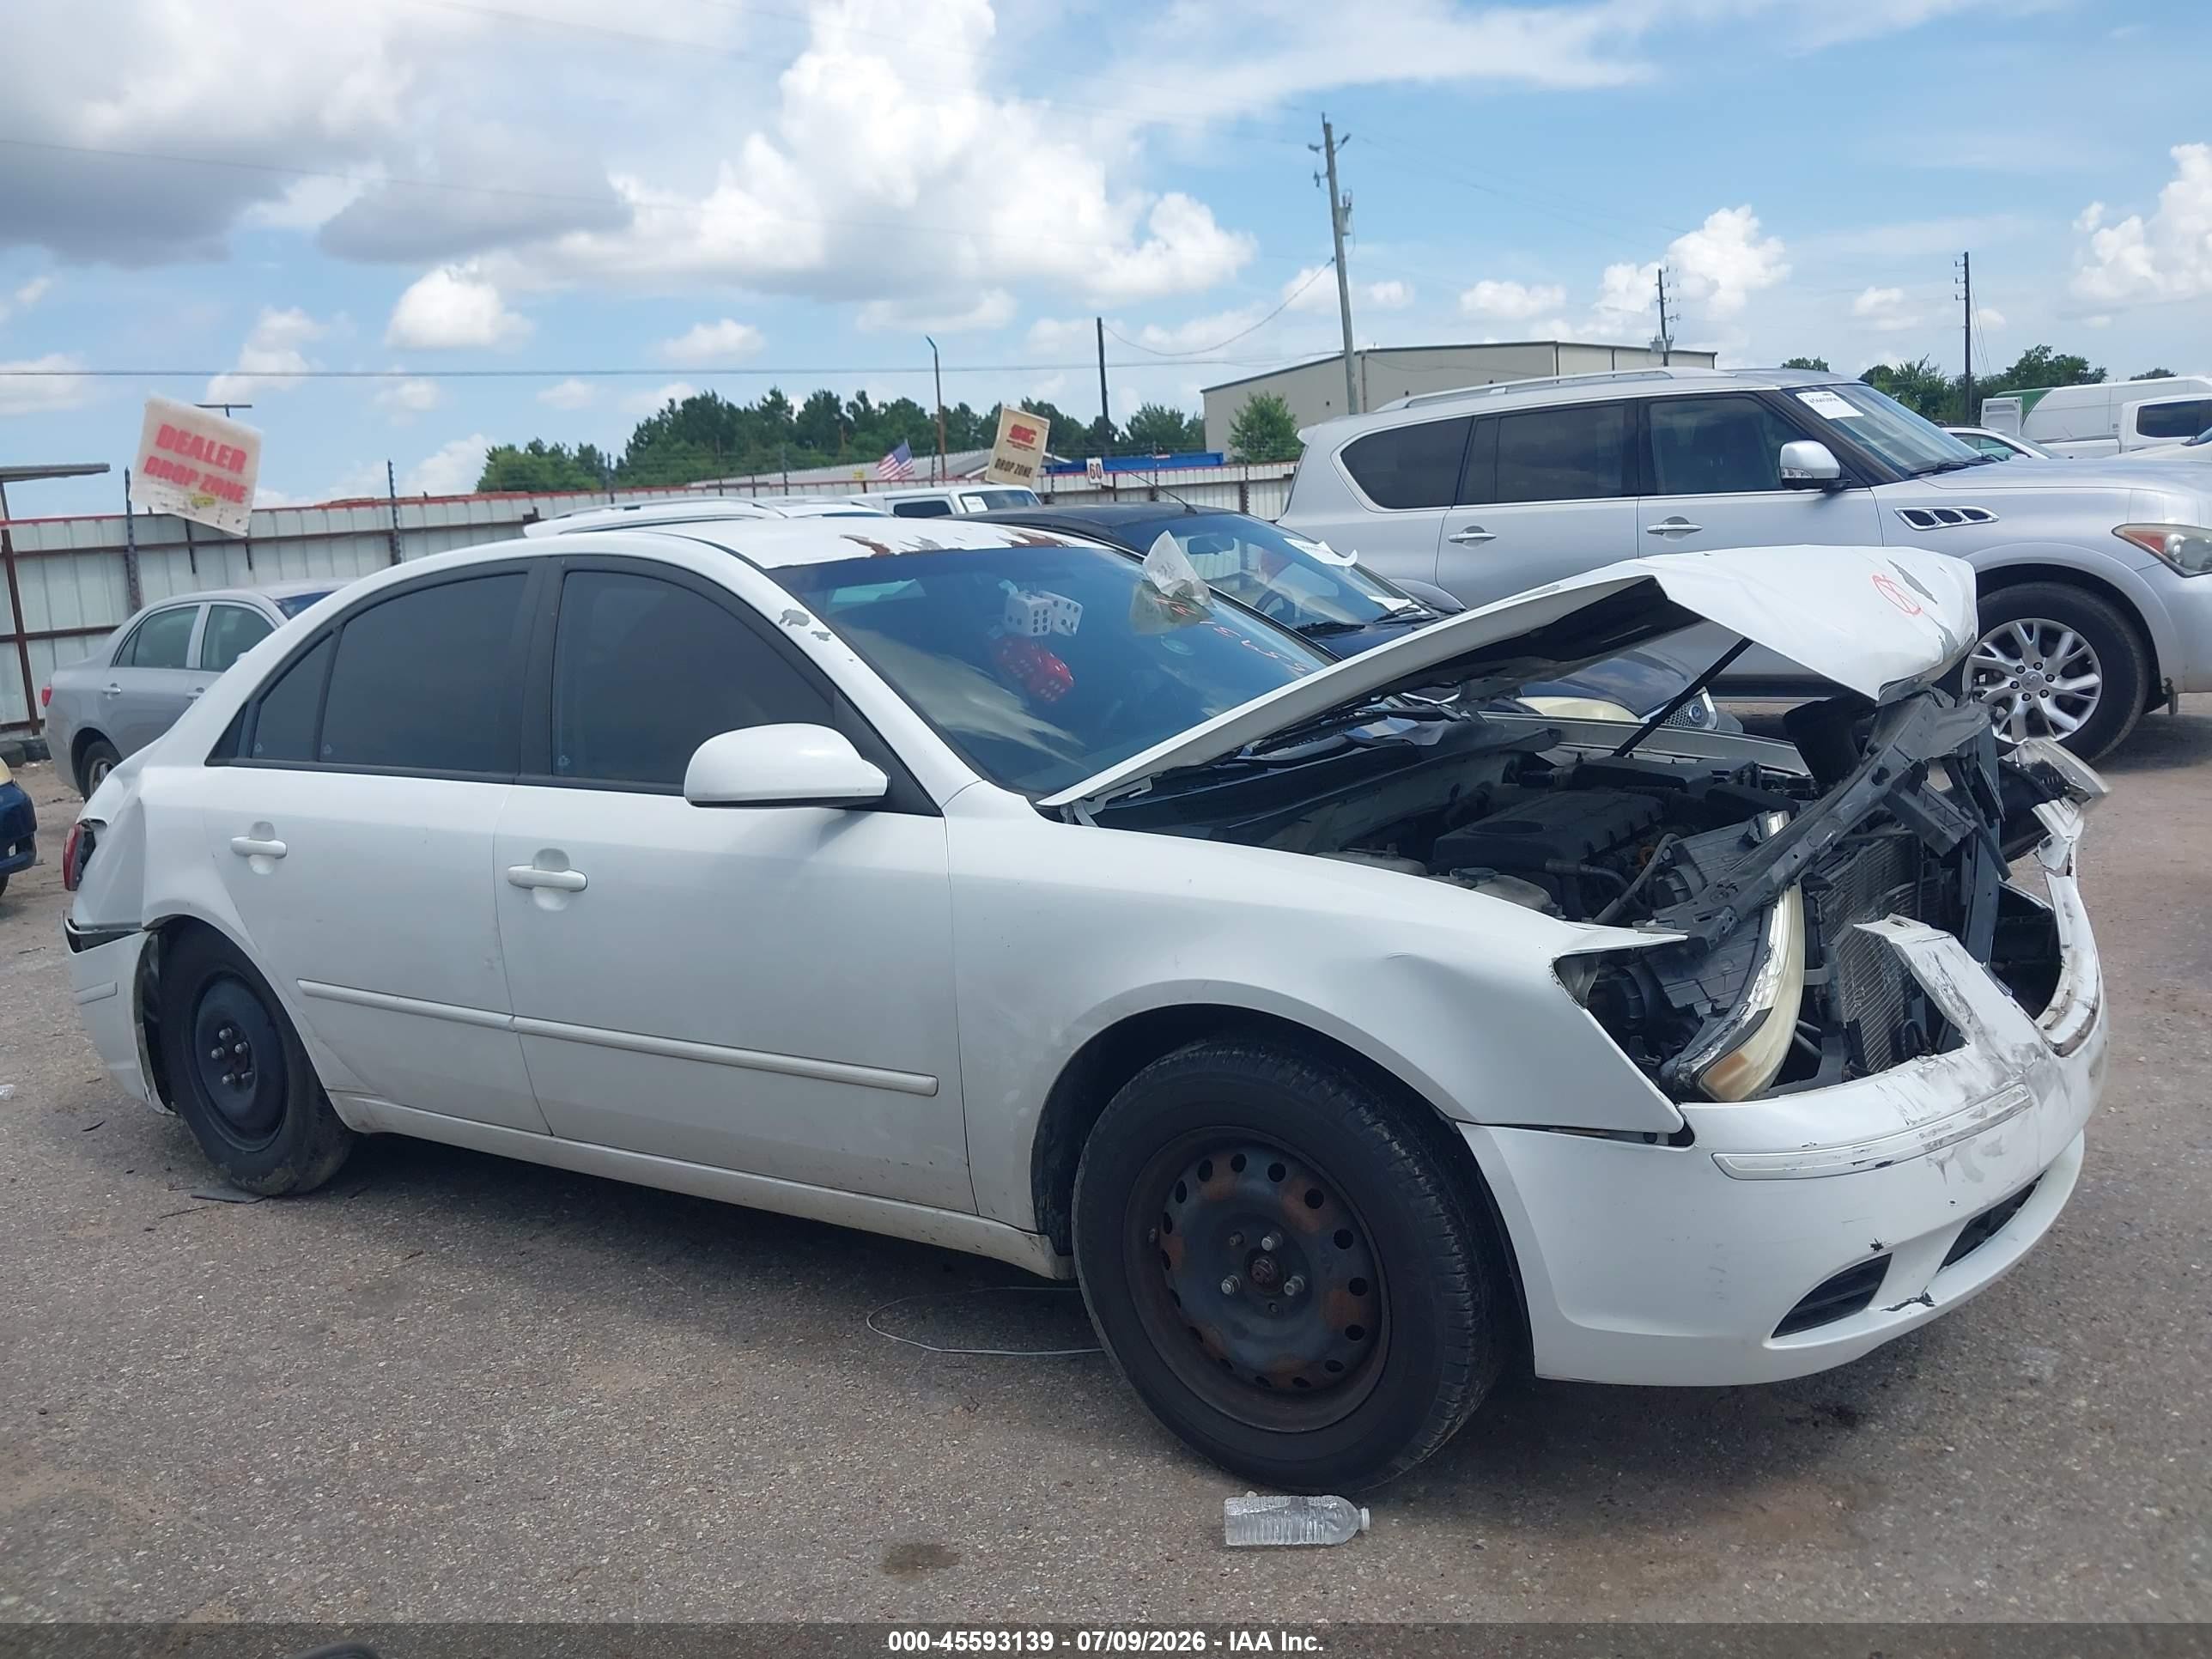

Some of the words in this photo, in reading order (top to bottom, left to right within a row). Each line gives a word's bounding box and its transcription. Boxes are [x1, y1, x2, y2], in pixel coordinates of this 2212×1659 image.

[155, 423, 247, 474] DEALER
[143, 455, 199, 486] DROP
[198, 473, 248, 504] ZONE
[994, 458, 1015, 472] DROP
[1013, 463, 1033, 478] ZONE
[1090, 463, 1102, 479] 60
